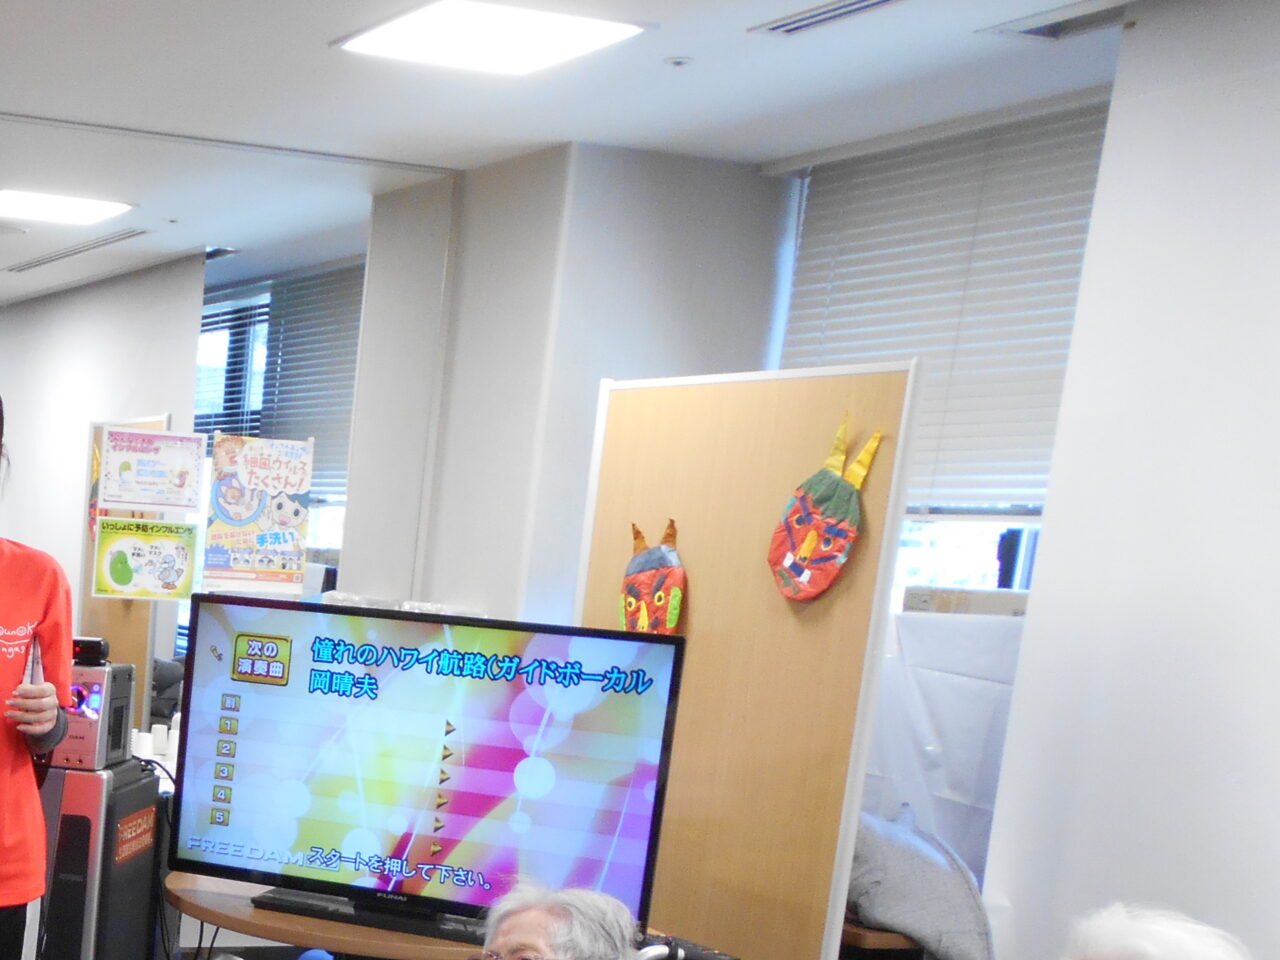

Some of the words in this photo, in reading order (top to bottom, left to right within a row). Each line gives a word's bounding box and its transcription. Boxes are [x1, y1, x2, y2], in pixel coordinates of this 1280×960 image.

[256, 531, 295, 547] 手洗い
[247, 640, 278, 657] 次の
[237, 657, 284, 678] 演奏曲
[309, 669, 378, 700] 岡晴夫
[224, 720, 231, 730] 1
[222, 743, 230, 753] 2
[220, 766, 228, 777] 3
[217, 789, 226, 800] 4
[216, 811, 224, 822] 5
[308, 846, 491, 890] スタートを押して下さい。
